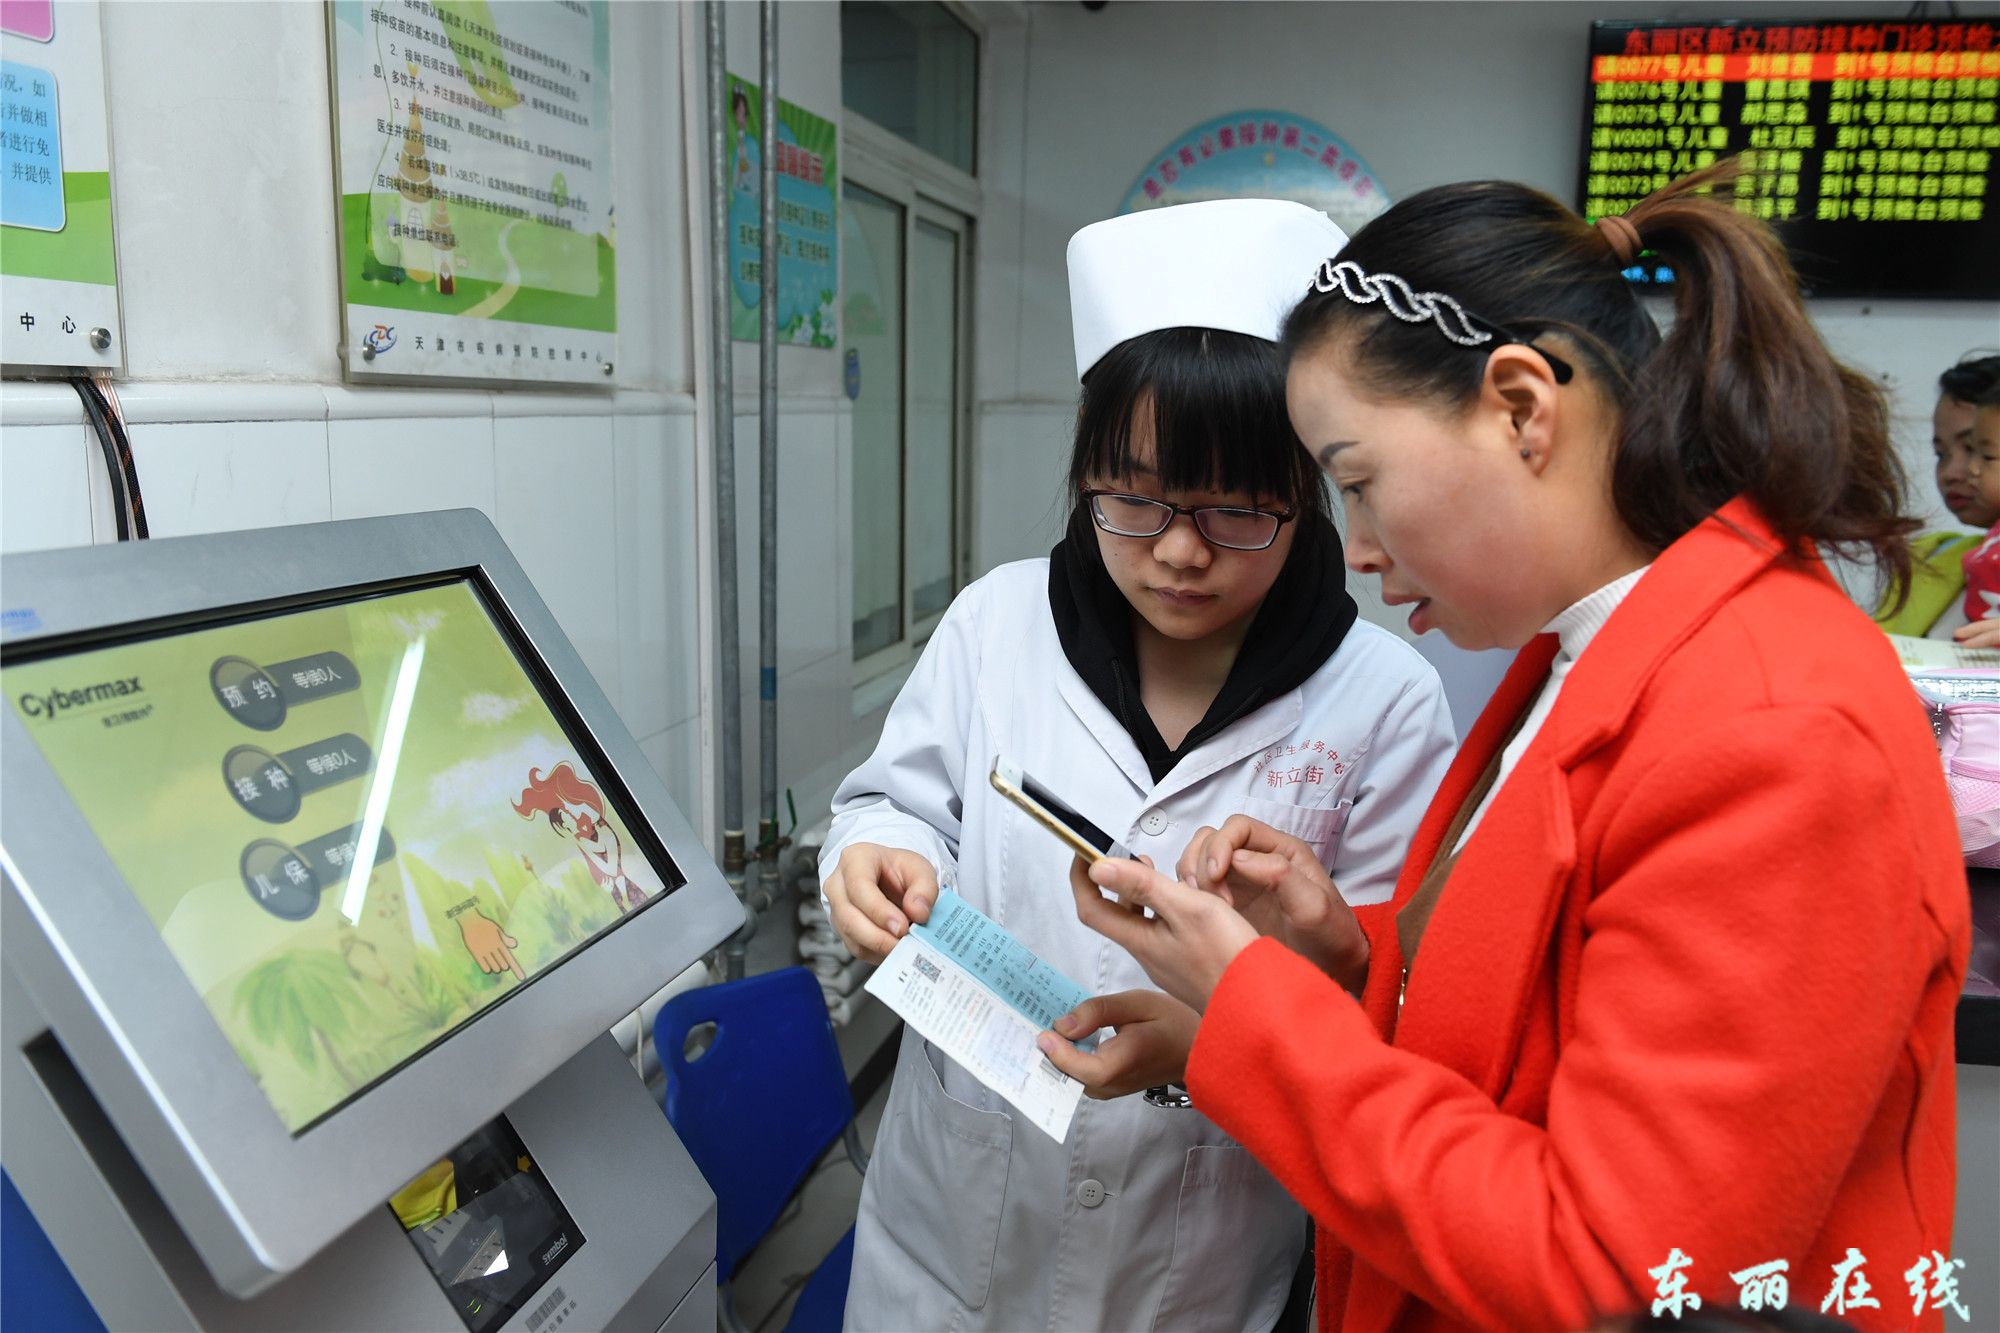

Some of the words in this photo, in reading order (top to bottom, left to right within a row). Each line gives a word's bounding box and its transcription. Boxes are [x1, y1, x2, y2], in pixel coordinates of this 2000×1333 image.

[1625, 25, 2000, 55] 东丽区新立预防接种门诊预检
[0, 73, 46, 97] 况，如
[0, 103, 48, 128] 并做相
[19, 312, 77, 334] 中心
[20, 676, 143, 720] Cybermax
[220, 678, 276, 708] 预约
[292, 665, 342, 689] 等候0人
[234, 765, 290, 802] 接种
[306, 749, 357, 775] 等候0人
[1267, 764, 1325, 788] 新立街
[253, 859, 310, 899] 儿保
[541, 1232, 569, 1266] symbol
